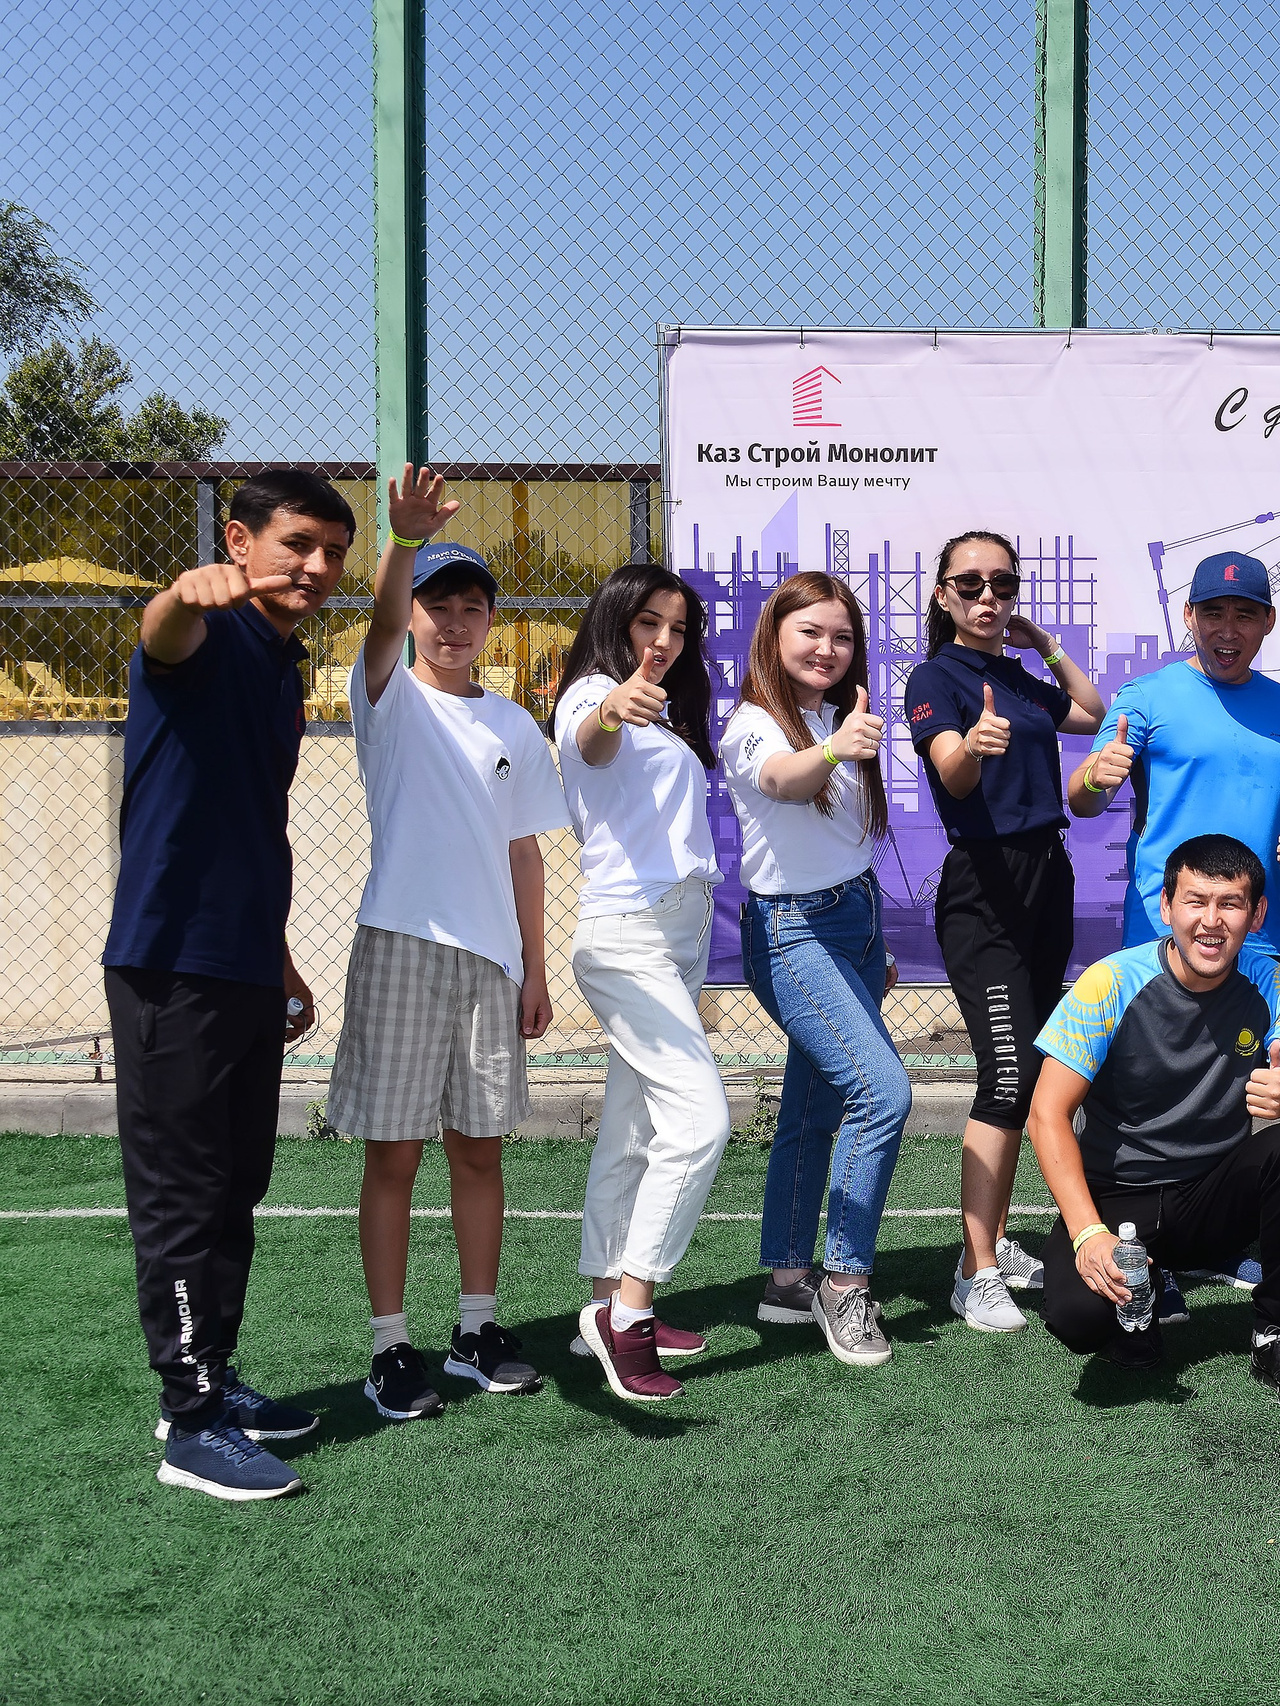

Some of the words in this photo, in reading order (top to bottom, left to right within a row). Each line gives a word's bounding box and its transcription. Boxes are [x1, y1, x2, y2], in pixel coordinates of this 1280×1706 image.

[1214, 387, 1249, 432] С
[697, 443, 741, 463] Каз
[747, 440, 821, 468] Строй
[827, 443, 938, 463] Монолит
[725, 474, 752, 488] Мы
[756, 476, 813, 490] строим
[817, 474, 859, 490] Вашу
[864, 476, 911, 490] мечту
[911, 709, 933, 724] TEAM
[913, 702, 930, 715] KSM
[746, 736, 764, 761] TEAM
[174, 1279, 194, 1354] ARMOUR
